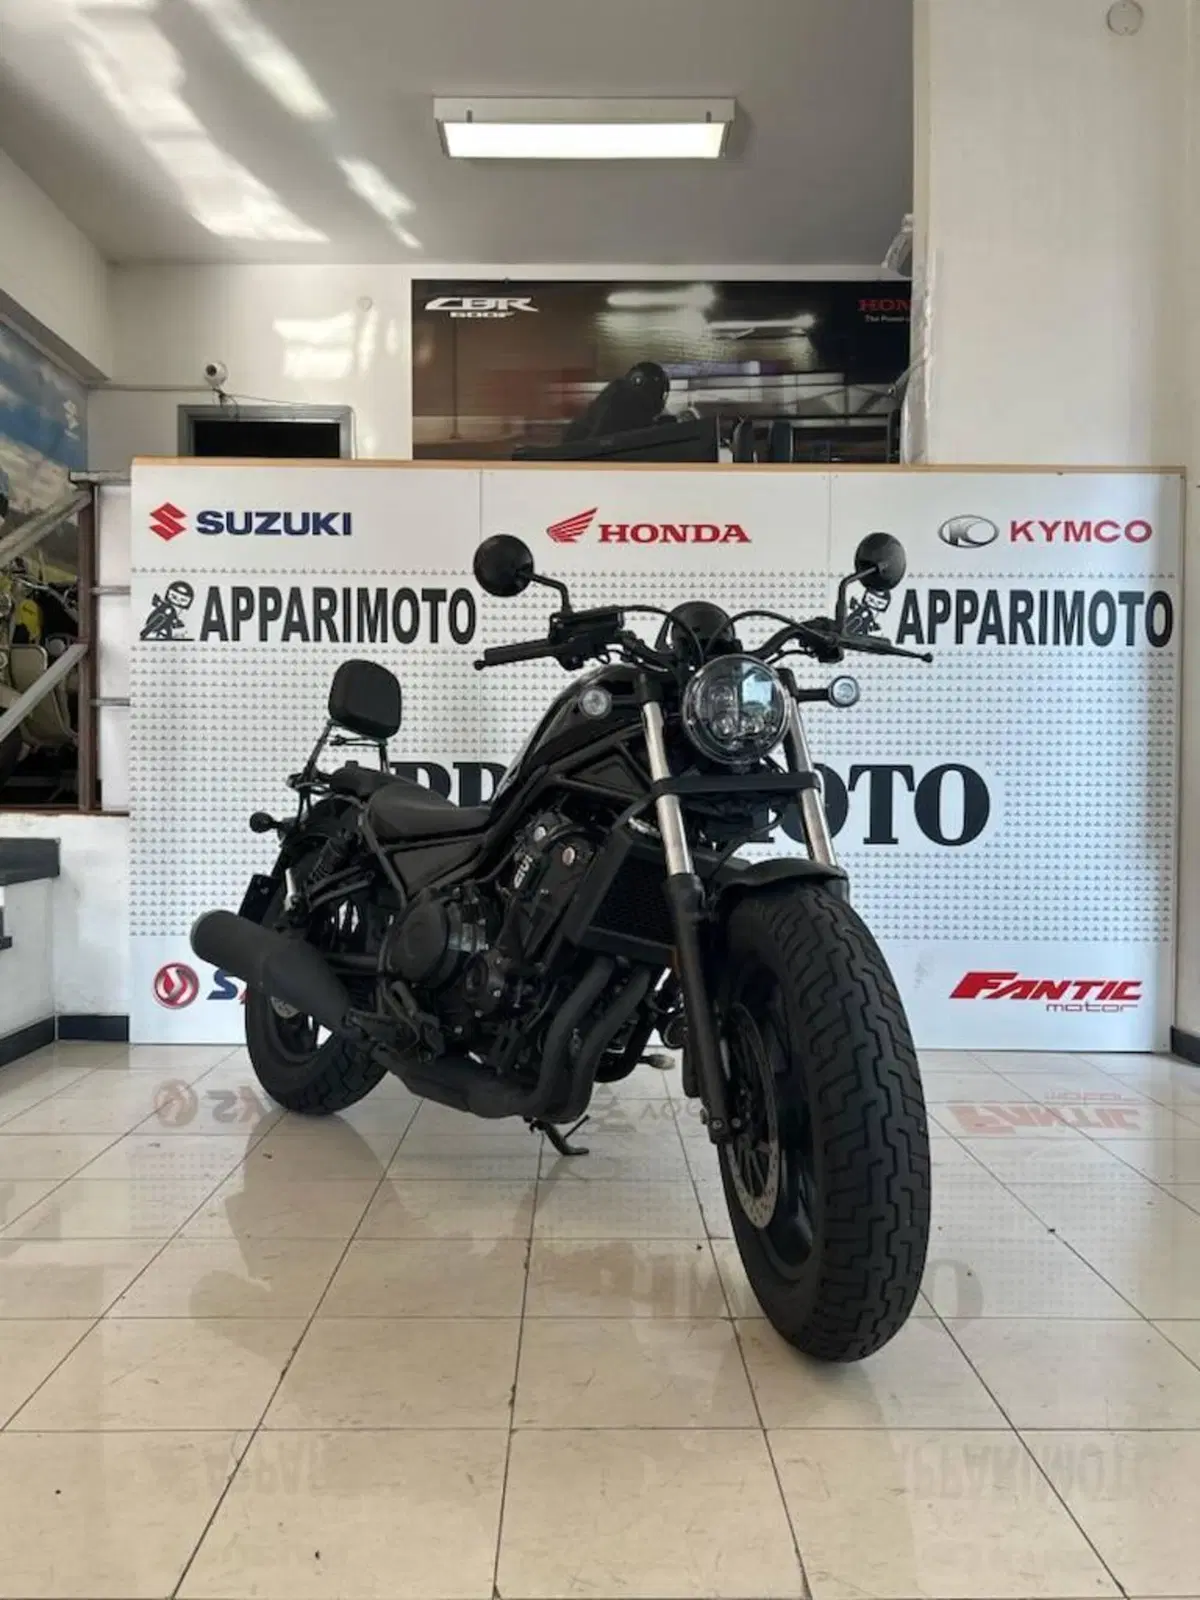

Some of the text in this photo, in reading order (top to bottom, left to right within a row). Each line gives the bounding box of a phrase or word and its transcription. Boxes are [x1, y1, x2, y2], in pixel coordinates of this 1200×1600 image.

[424, 297, 539, 312] CBR
[857, 299, 911, 312] HON
[196, 511, 352, 536] SUZUKI
[598, 524, 752, 543] HONDA
[1009, 519, 1152, 543] KYMCO
[199, 585, 476, 645] APPARIMOTO
[895, 588, 1174, 648] APPARIMOTO
[949, 972, 1142, 1000] FANTIC
[1045, 1001, 1138, 1013] motor
